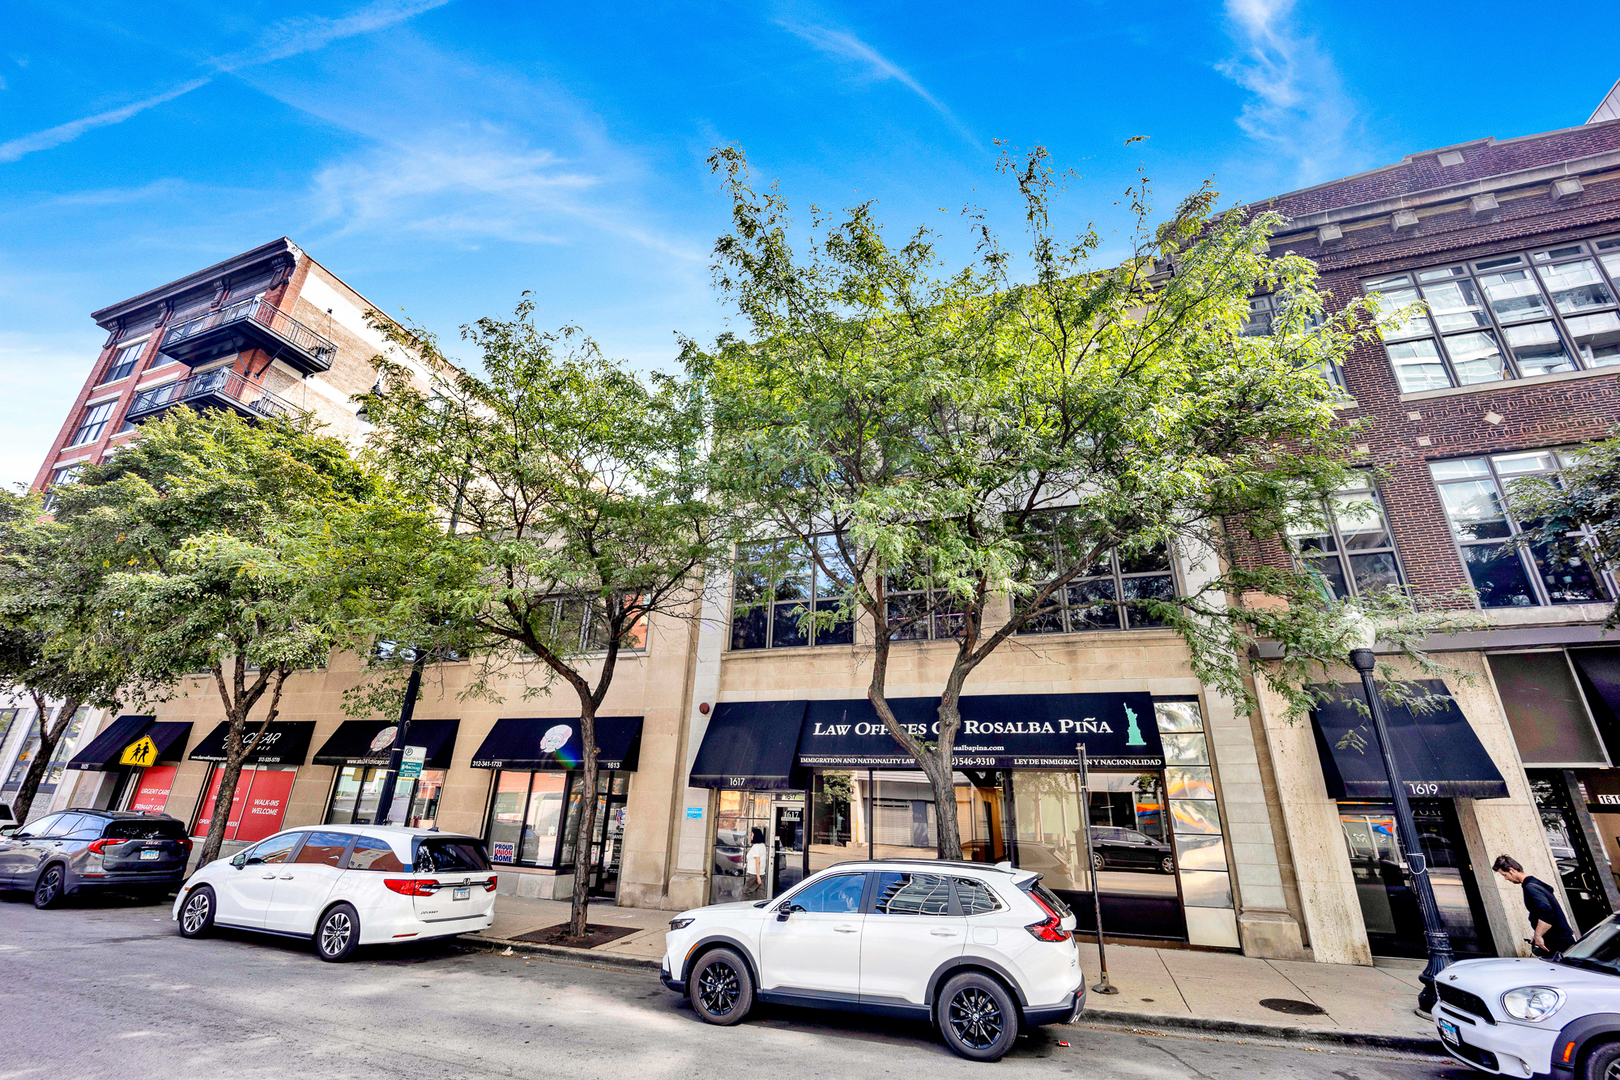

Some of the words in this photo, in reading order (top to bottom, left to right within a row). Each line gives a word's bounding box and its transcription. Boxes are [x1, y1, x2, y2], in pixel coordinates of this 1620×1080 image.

[813, 722, 851, 736] LAW
[854, 721, 927, 736] OFFES
[963, 720, 1054, 734] ROSALBA
[1058, 717, 1114, 734] PIÑA
[1040, 758, 1093, 766] INMIGRACN
[729, 777, 746, 786] 1617
[1409, 783, 1439, 795] 1619
[254, 798, 280, 807] WALK-INS
[251, 807, 279, 816] WELCOME
[494, 848, 513, 856] UNION
